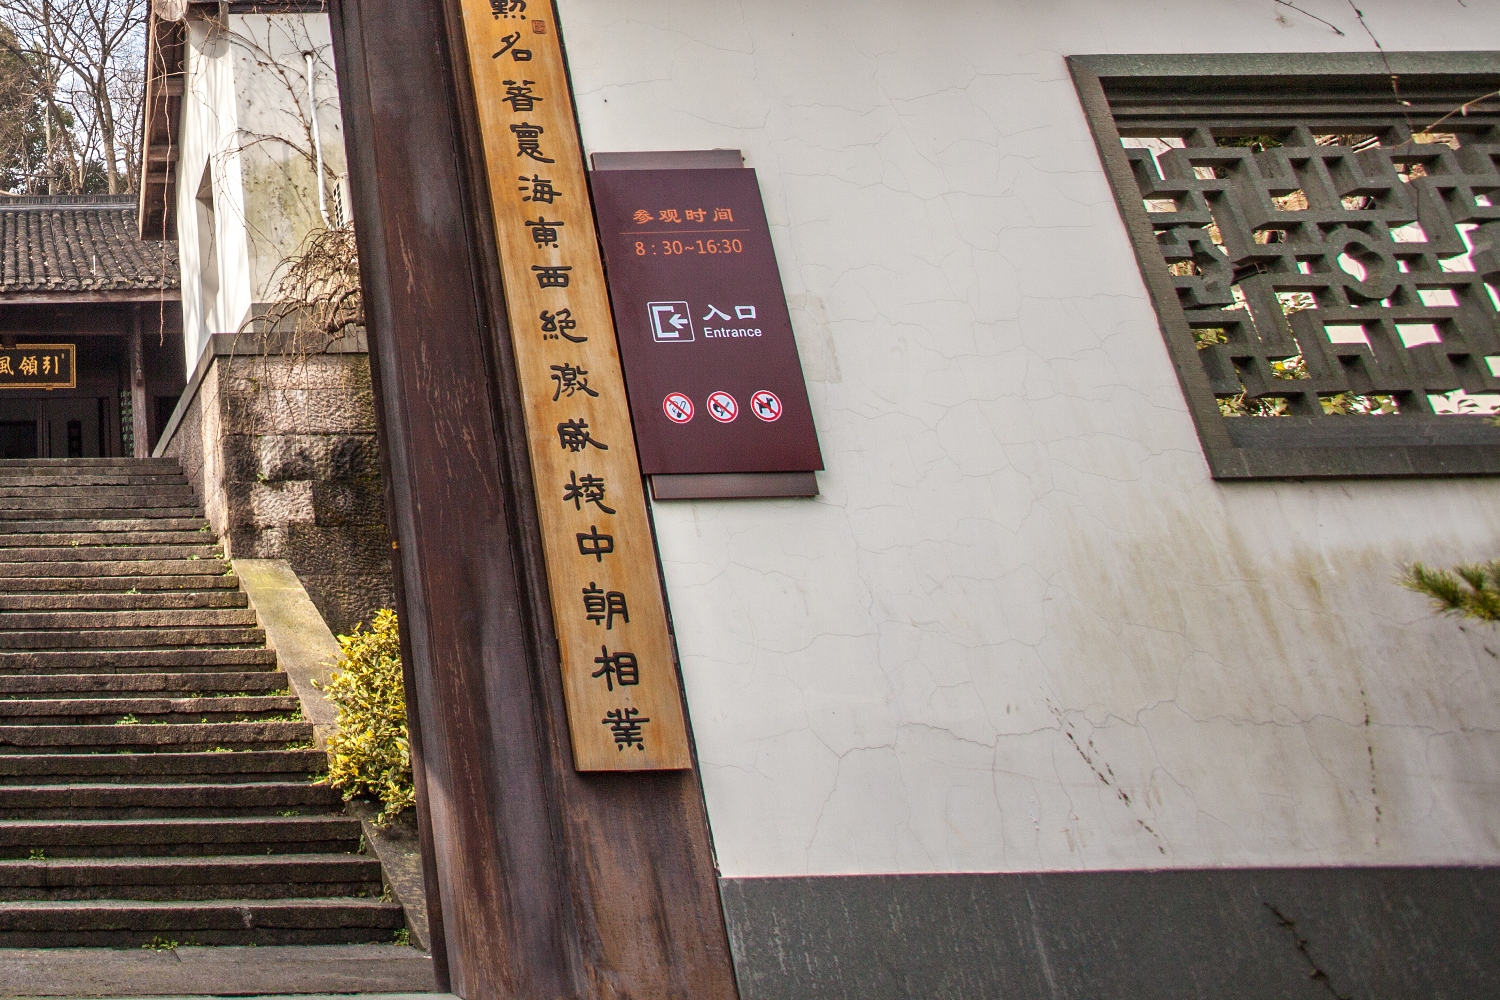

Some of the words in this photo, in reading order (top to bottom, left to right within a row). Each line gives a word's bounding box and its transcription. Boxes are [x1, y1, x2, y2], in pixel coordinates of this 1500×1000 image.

[632, 207, 734, 225] 参观时间
[702, 303, 757, 321] 入口
[703, 326, 762, 339] Entrance
